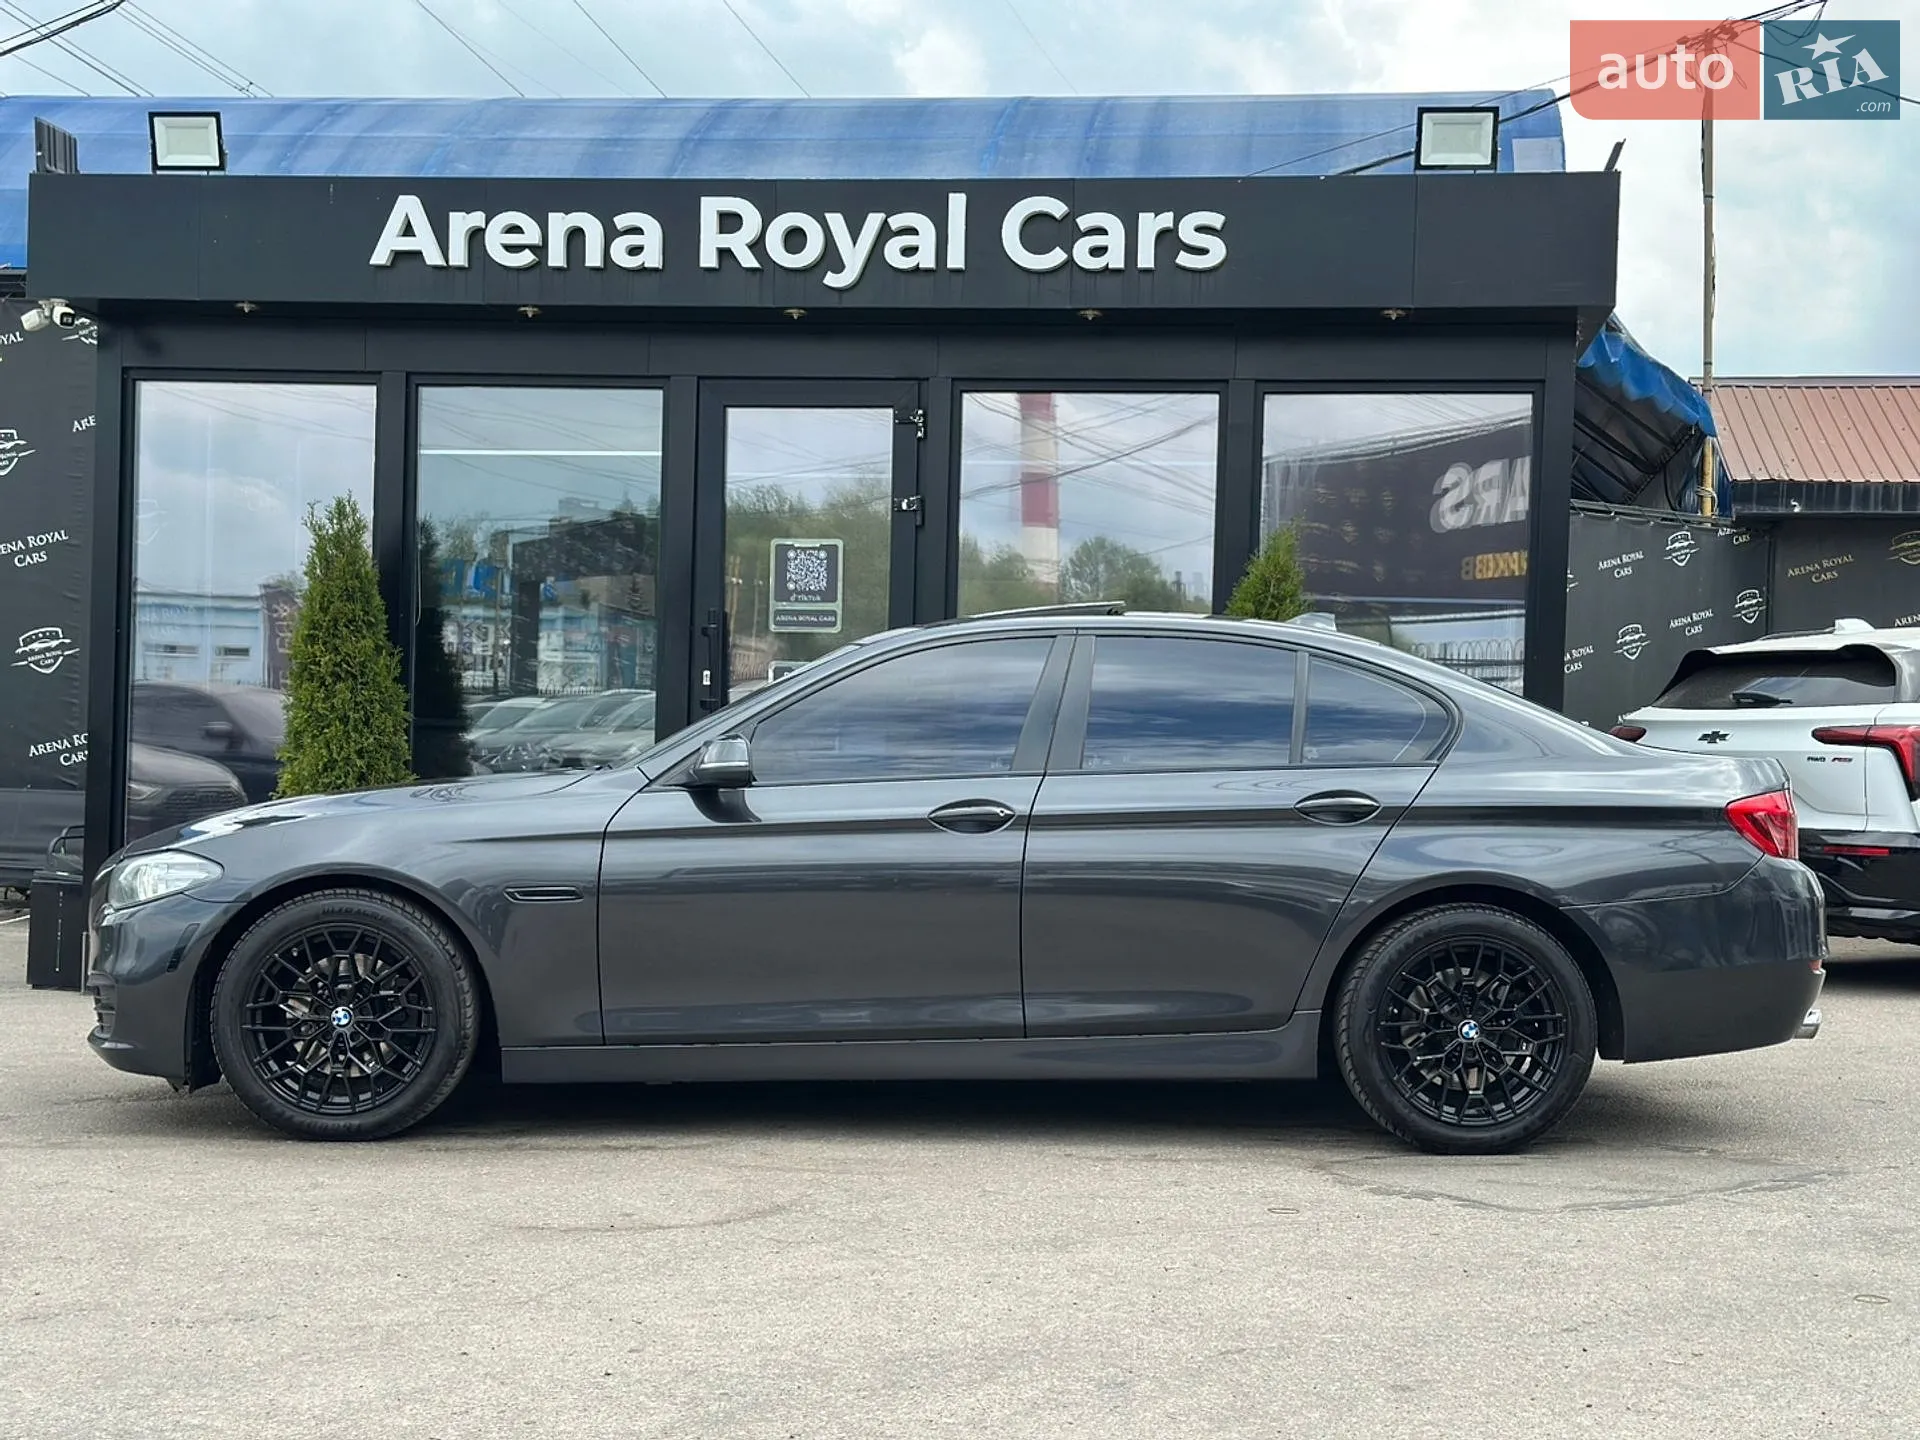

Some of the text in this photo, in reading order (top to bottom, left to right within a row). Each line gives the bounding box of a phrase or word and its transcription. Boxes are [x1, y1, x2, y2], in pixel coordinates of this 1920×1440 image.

[369, 192, 1228, 290] Arena Royal Cars
[0, 530, 69, 555] ENA ROYAL
[14, 551, 48, 567] CARS
[1598, 550, 1645, 570] ARENA ROYAL
[1786, 554, 1855, 577] ARENA ROYAL
[1614, 566, 1632, 578] CARS
[1811, 570, 1839, 583] CARS
[1669, 609, 1714, 629] ARENA ROYAL
[1685, 624, 1703, 636] CARS
[1572, 645, 1594, 660] ROYAL
[1564, 661, 1583, 674] CARS
[29, 739, 72, 757] ARENA
